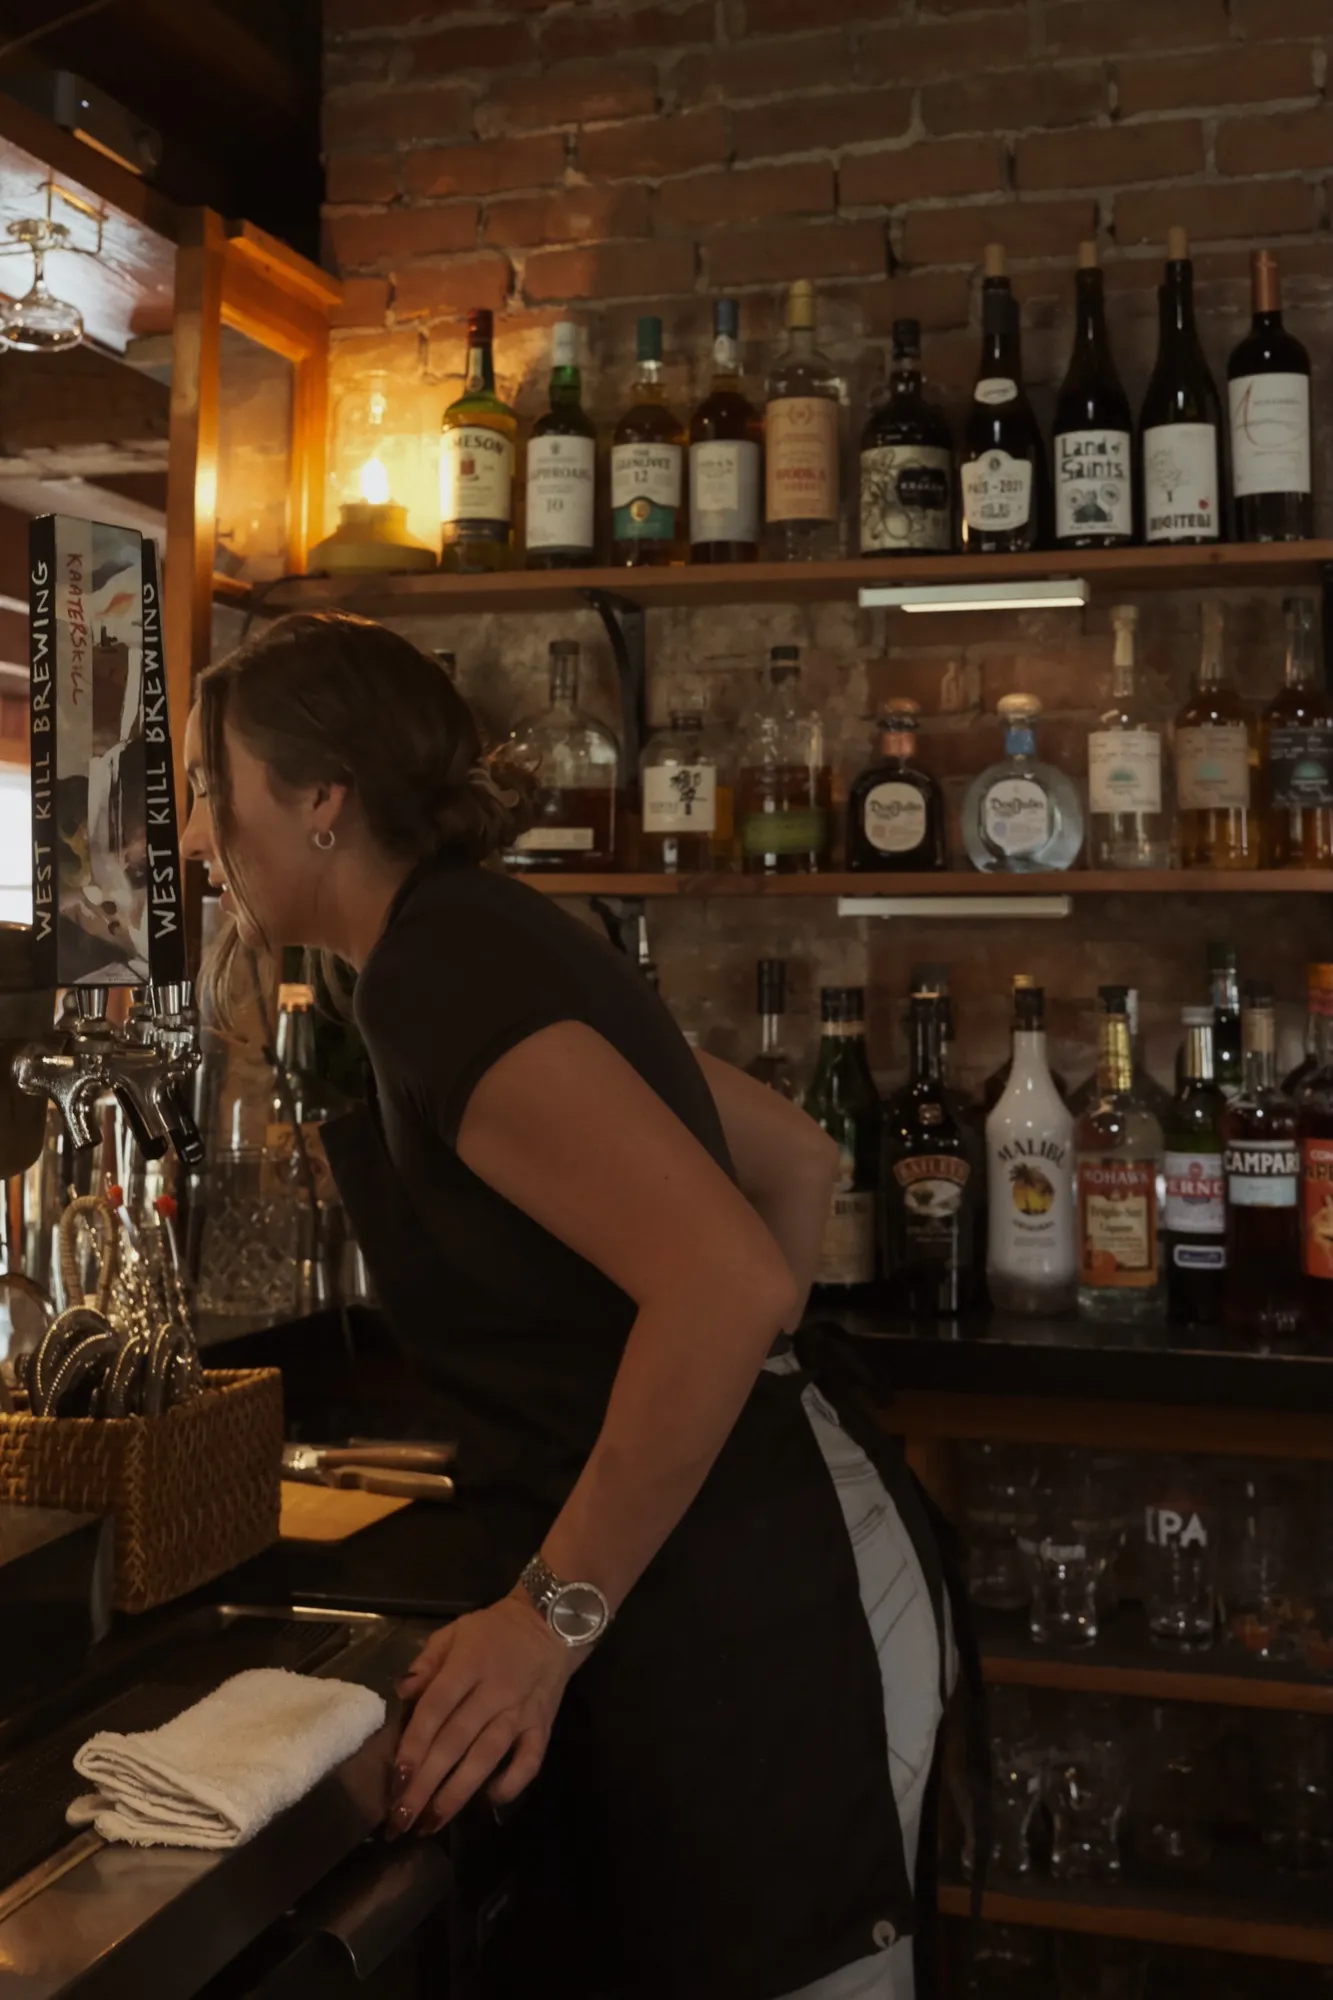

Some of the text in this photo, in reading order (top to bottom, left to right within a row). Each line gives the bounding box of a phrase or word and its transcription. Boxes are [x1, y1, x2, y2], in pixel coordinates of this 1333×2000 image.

[1061, 436, 1108, 459] Land
[634, 469, 649, 484] 12
[1060, 457, 1125, 483] Saints
[30, 559, 54, 942] WEST KILL BREWING
[147, 759, 172, 826] KILL
[147, 842, 178, 939] WEST
[1145, 1505, 1208, 1549] IPA
